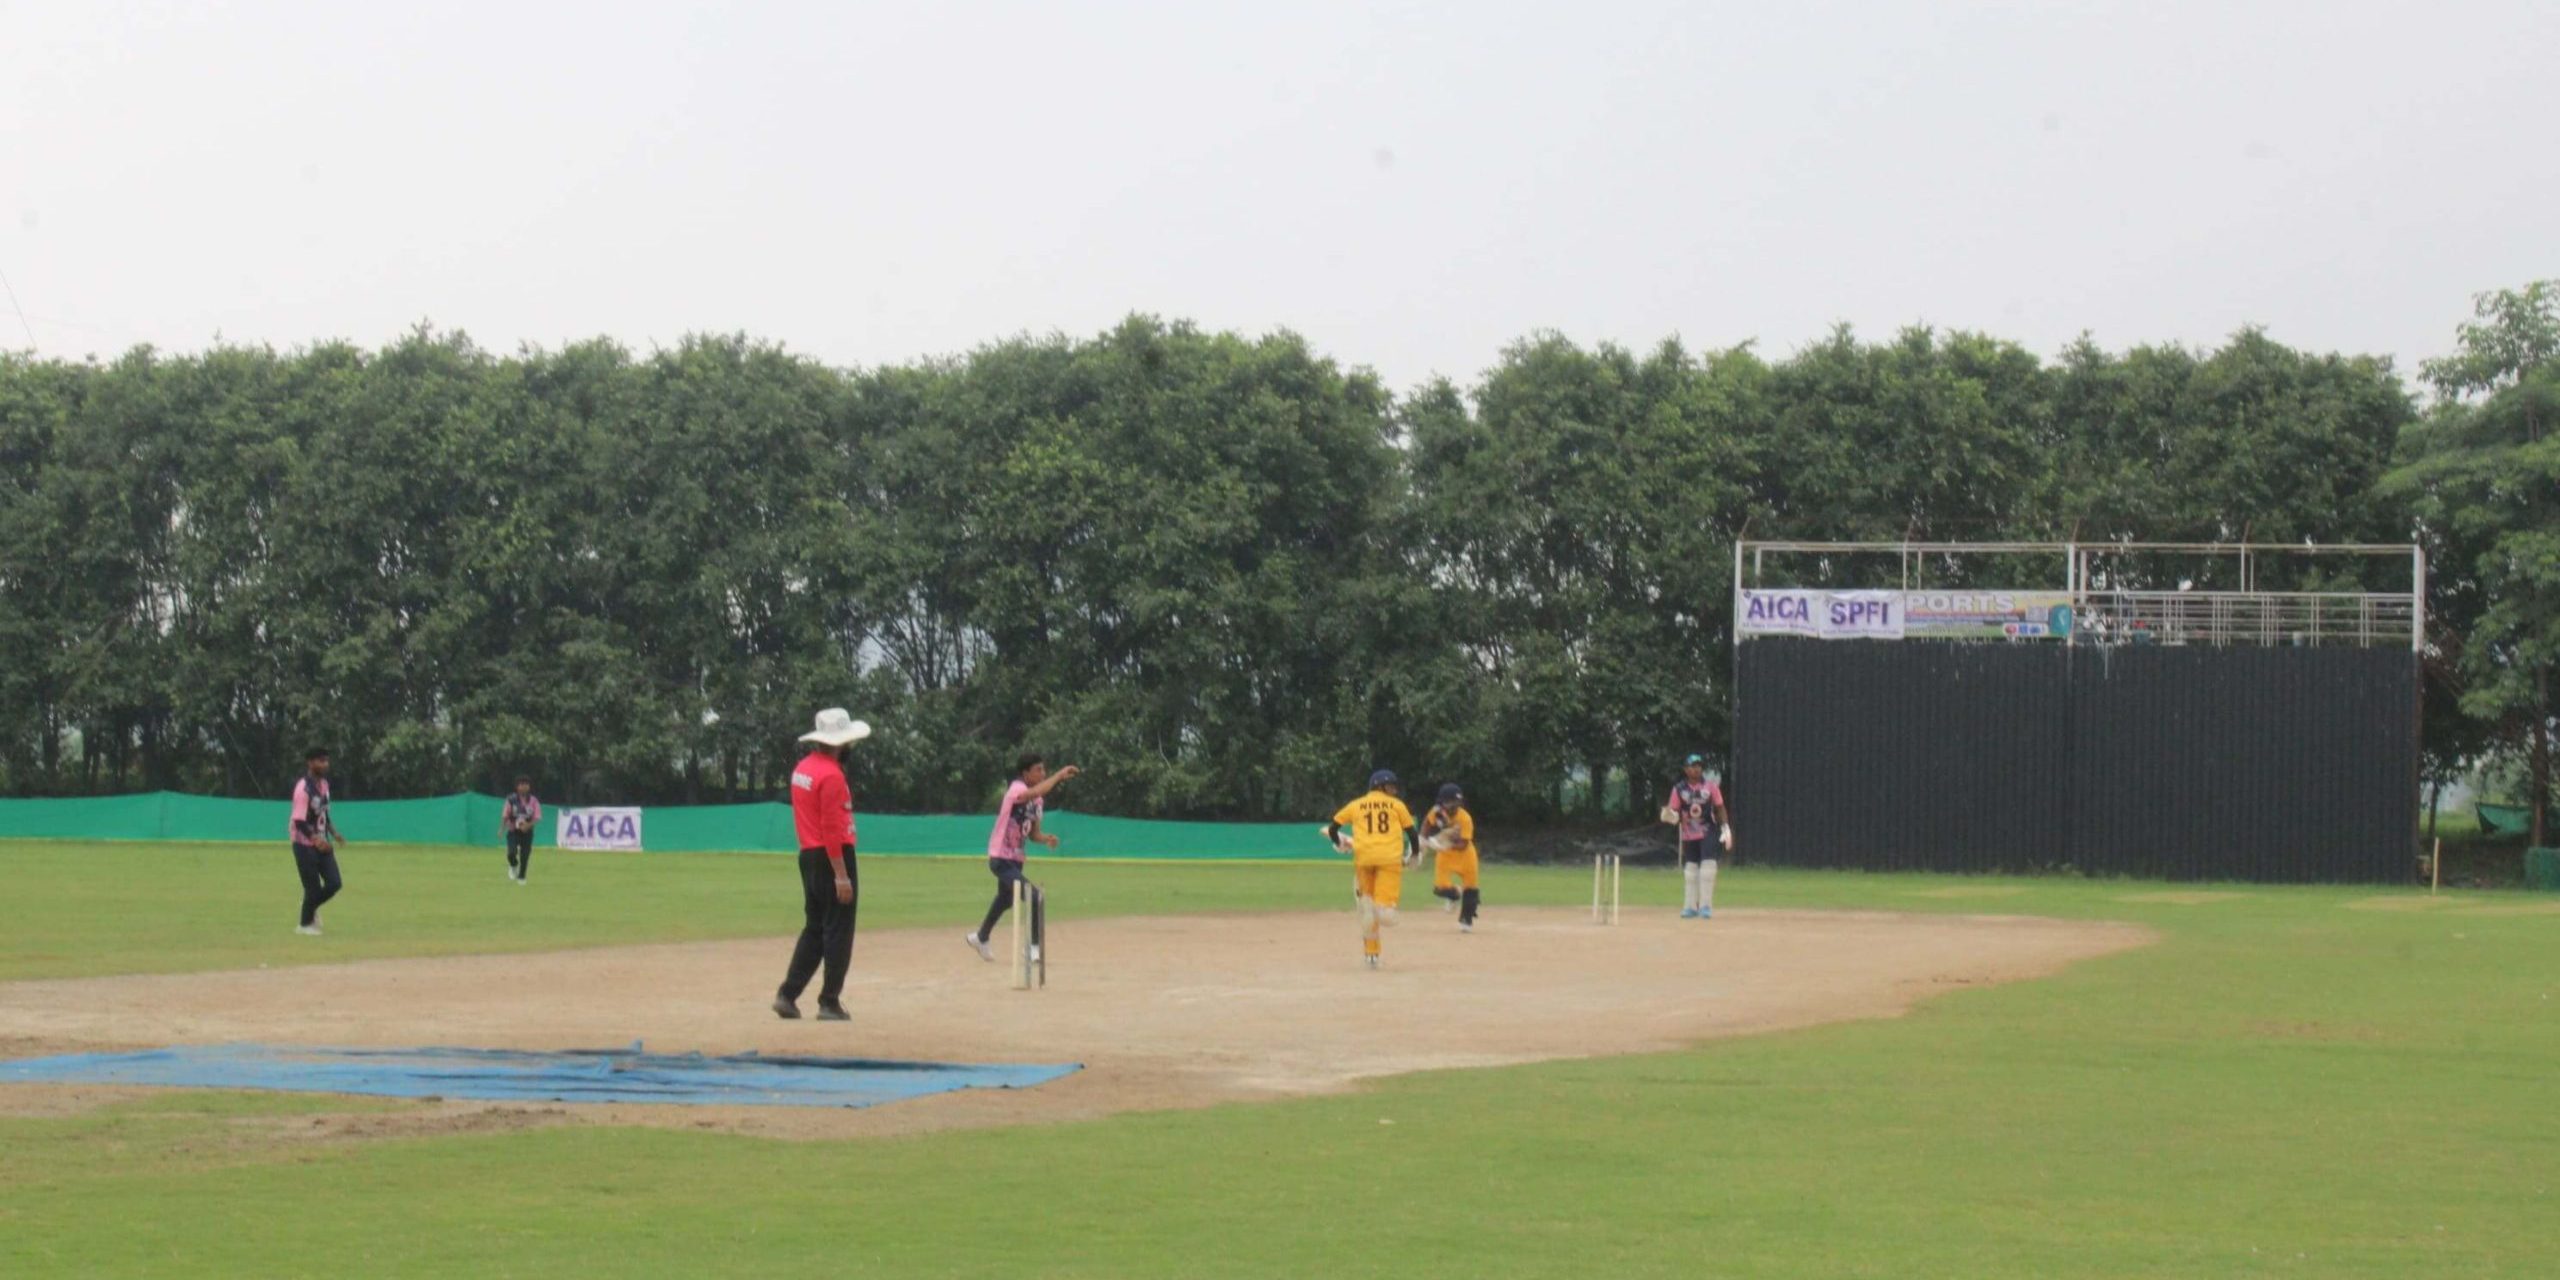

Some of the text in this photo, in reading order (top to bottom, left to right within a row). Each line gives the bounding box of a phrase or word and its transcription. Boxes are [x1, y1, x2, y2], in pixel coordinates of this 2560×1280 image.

[1747, 595, 1809, 622] AICA
[1830, 601, 1888, 625] SPFI
[1905, 594, 2015, 613] PORTS
[1360, 802, 1393, 810] NIKKI
[566, 815, 636, 839] AICA
[1364, 811, 1389, 834] 18
